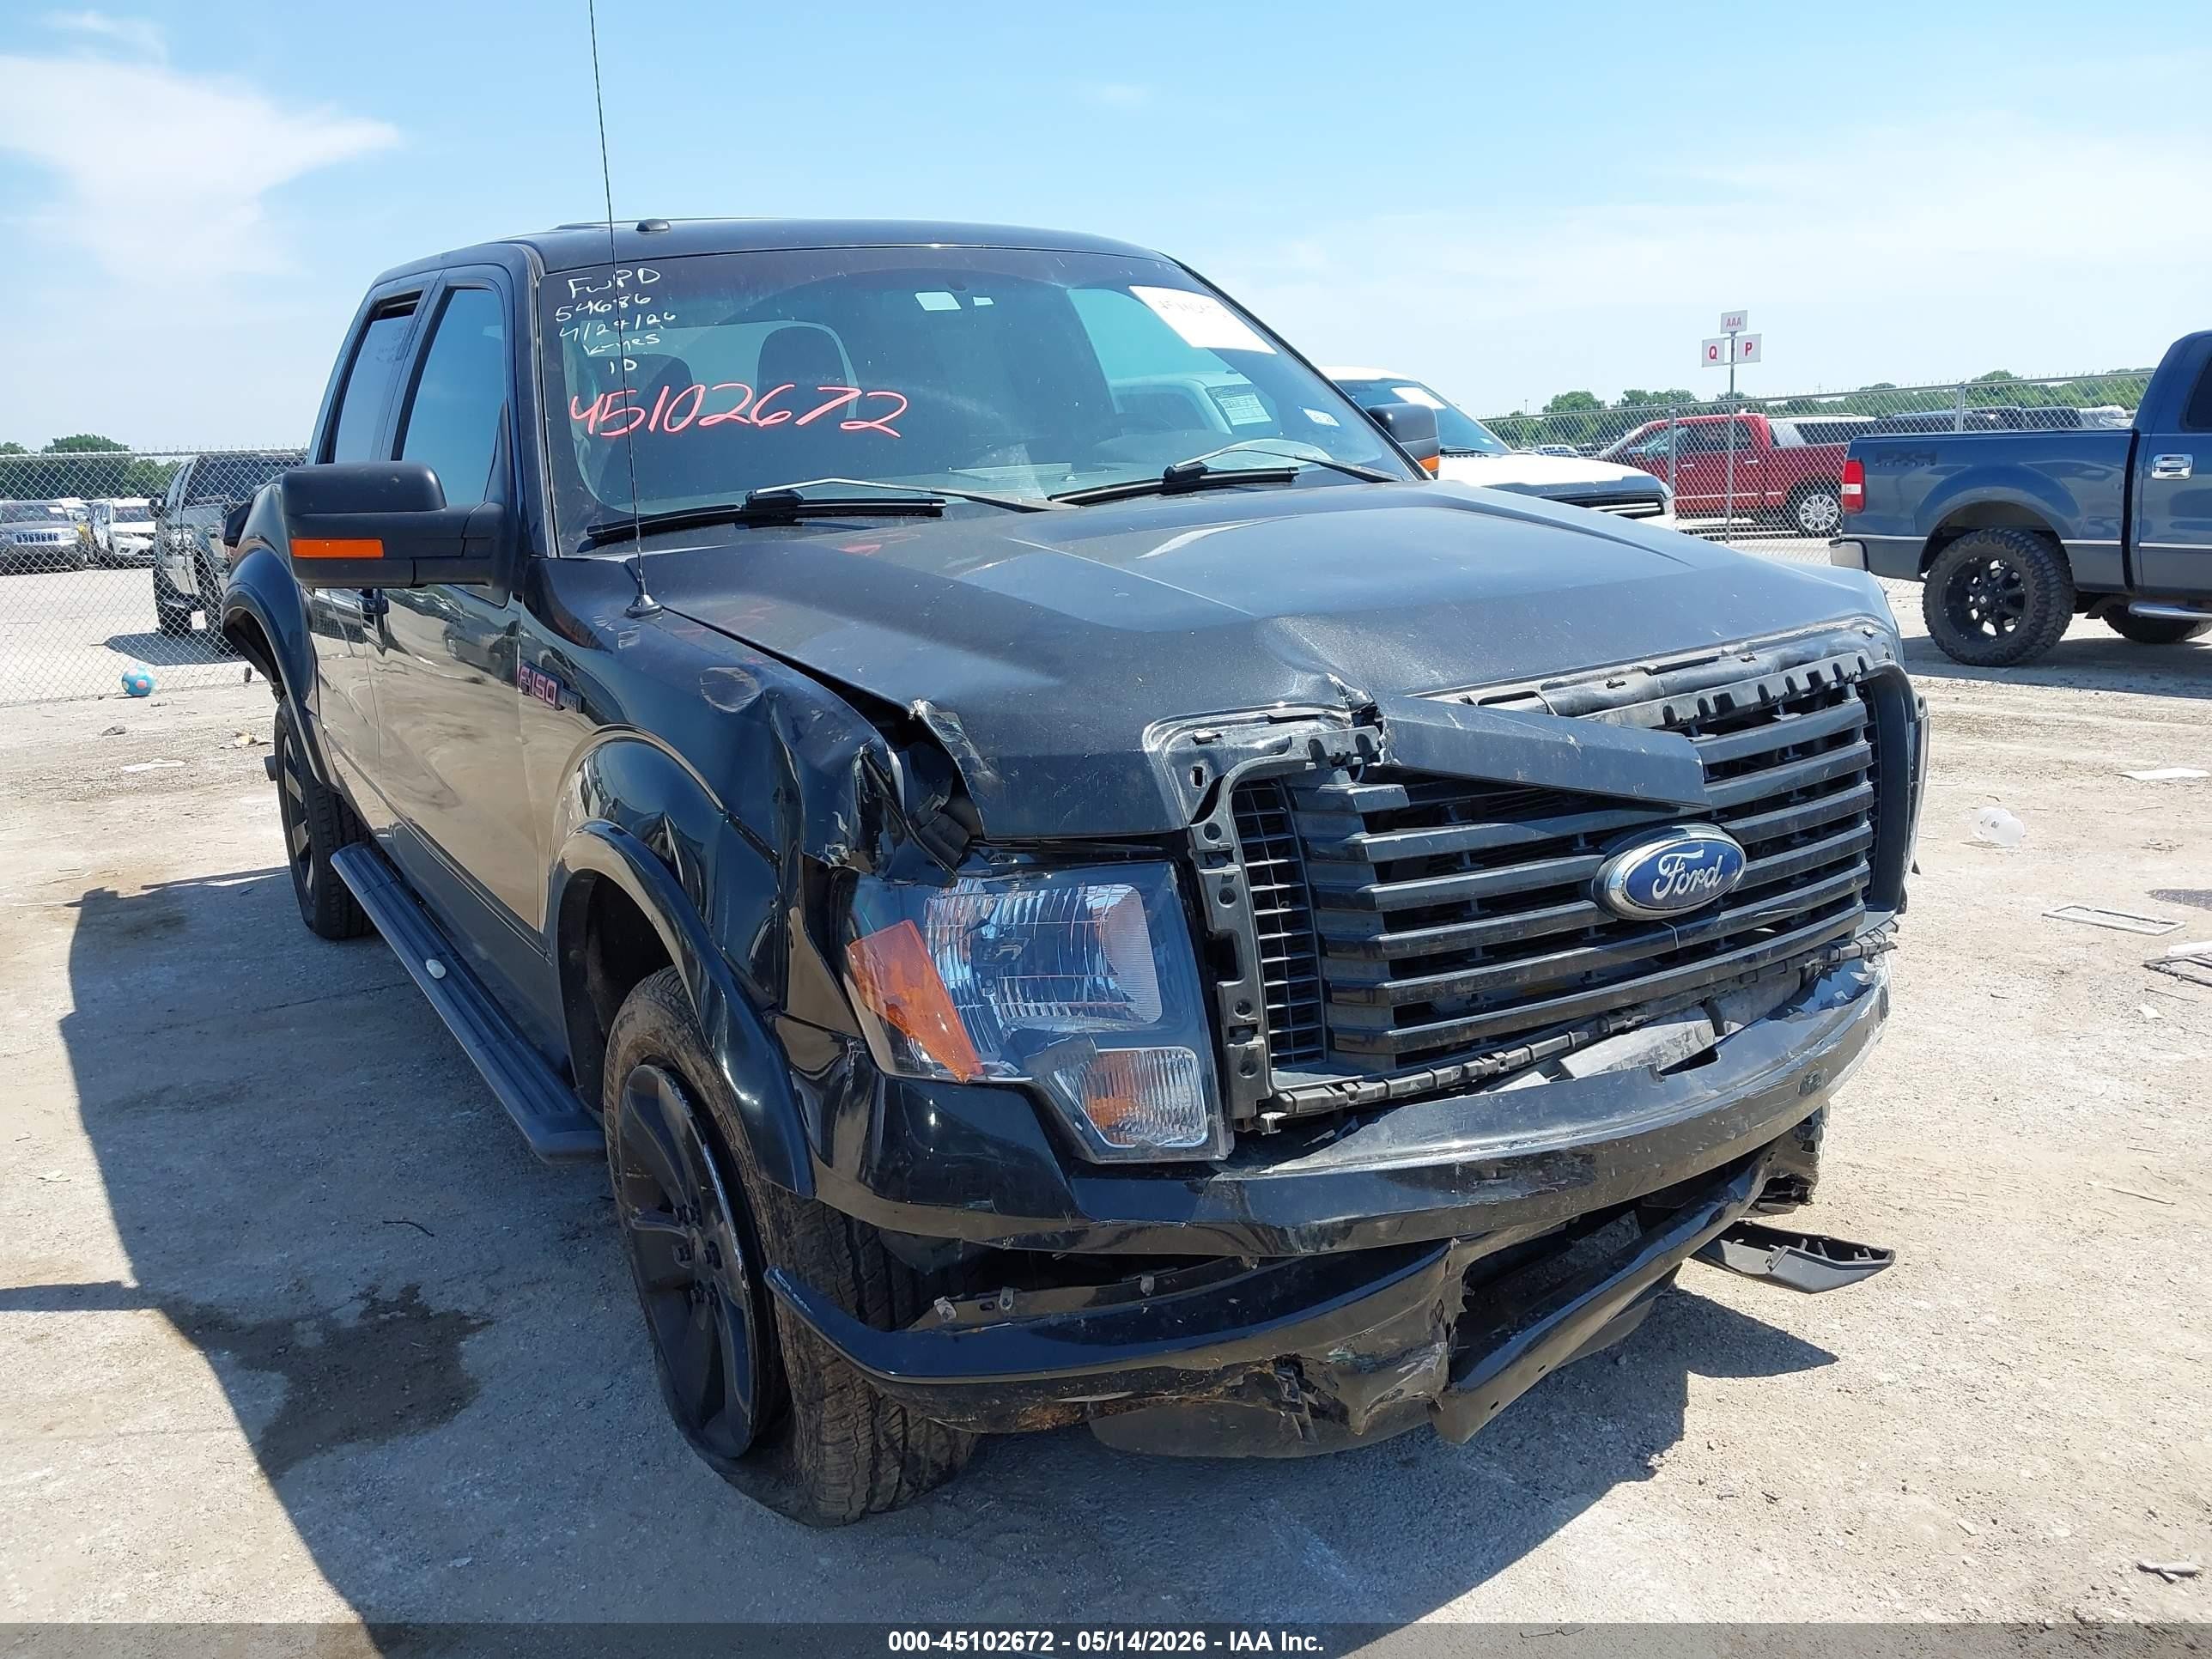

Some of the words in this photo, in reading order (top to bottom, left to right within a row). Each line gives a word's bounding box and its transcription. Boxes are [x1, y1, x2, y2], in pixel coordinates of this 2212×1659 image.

[1726, 316, 1741, 328] AAA
[1709, 345, 1717, 360] Q
[1745, 342, 1753, 357] P
[570, 383, 908, 438] 45102672
[1651, 848, 1724, 901] Ford
